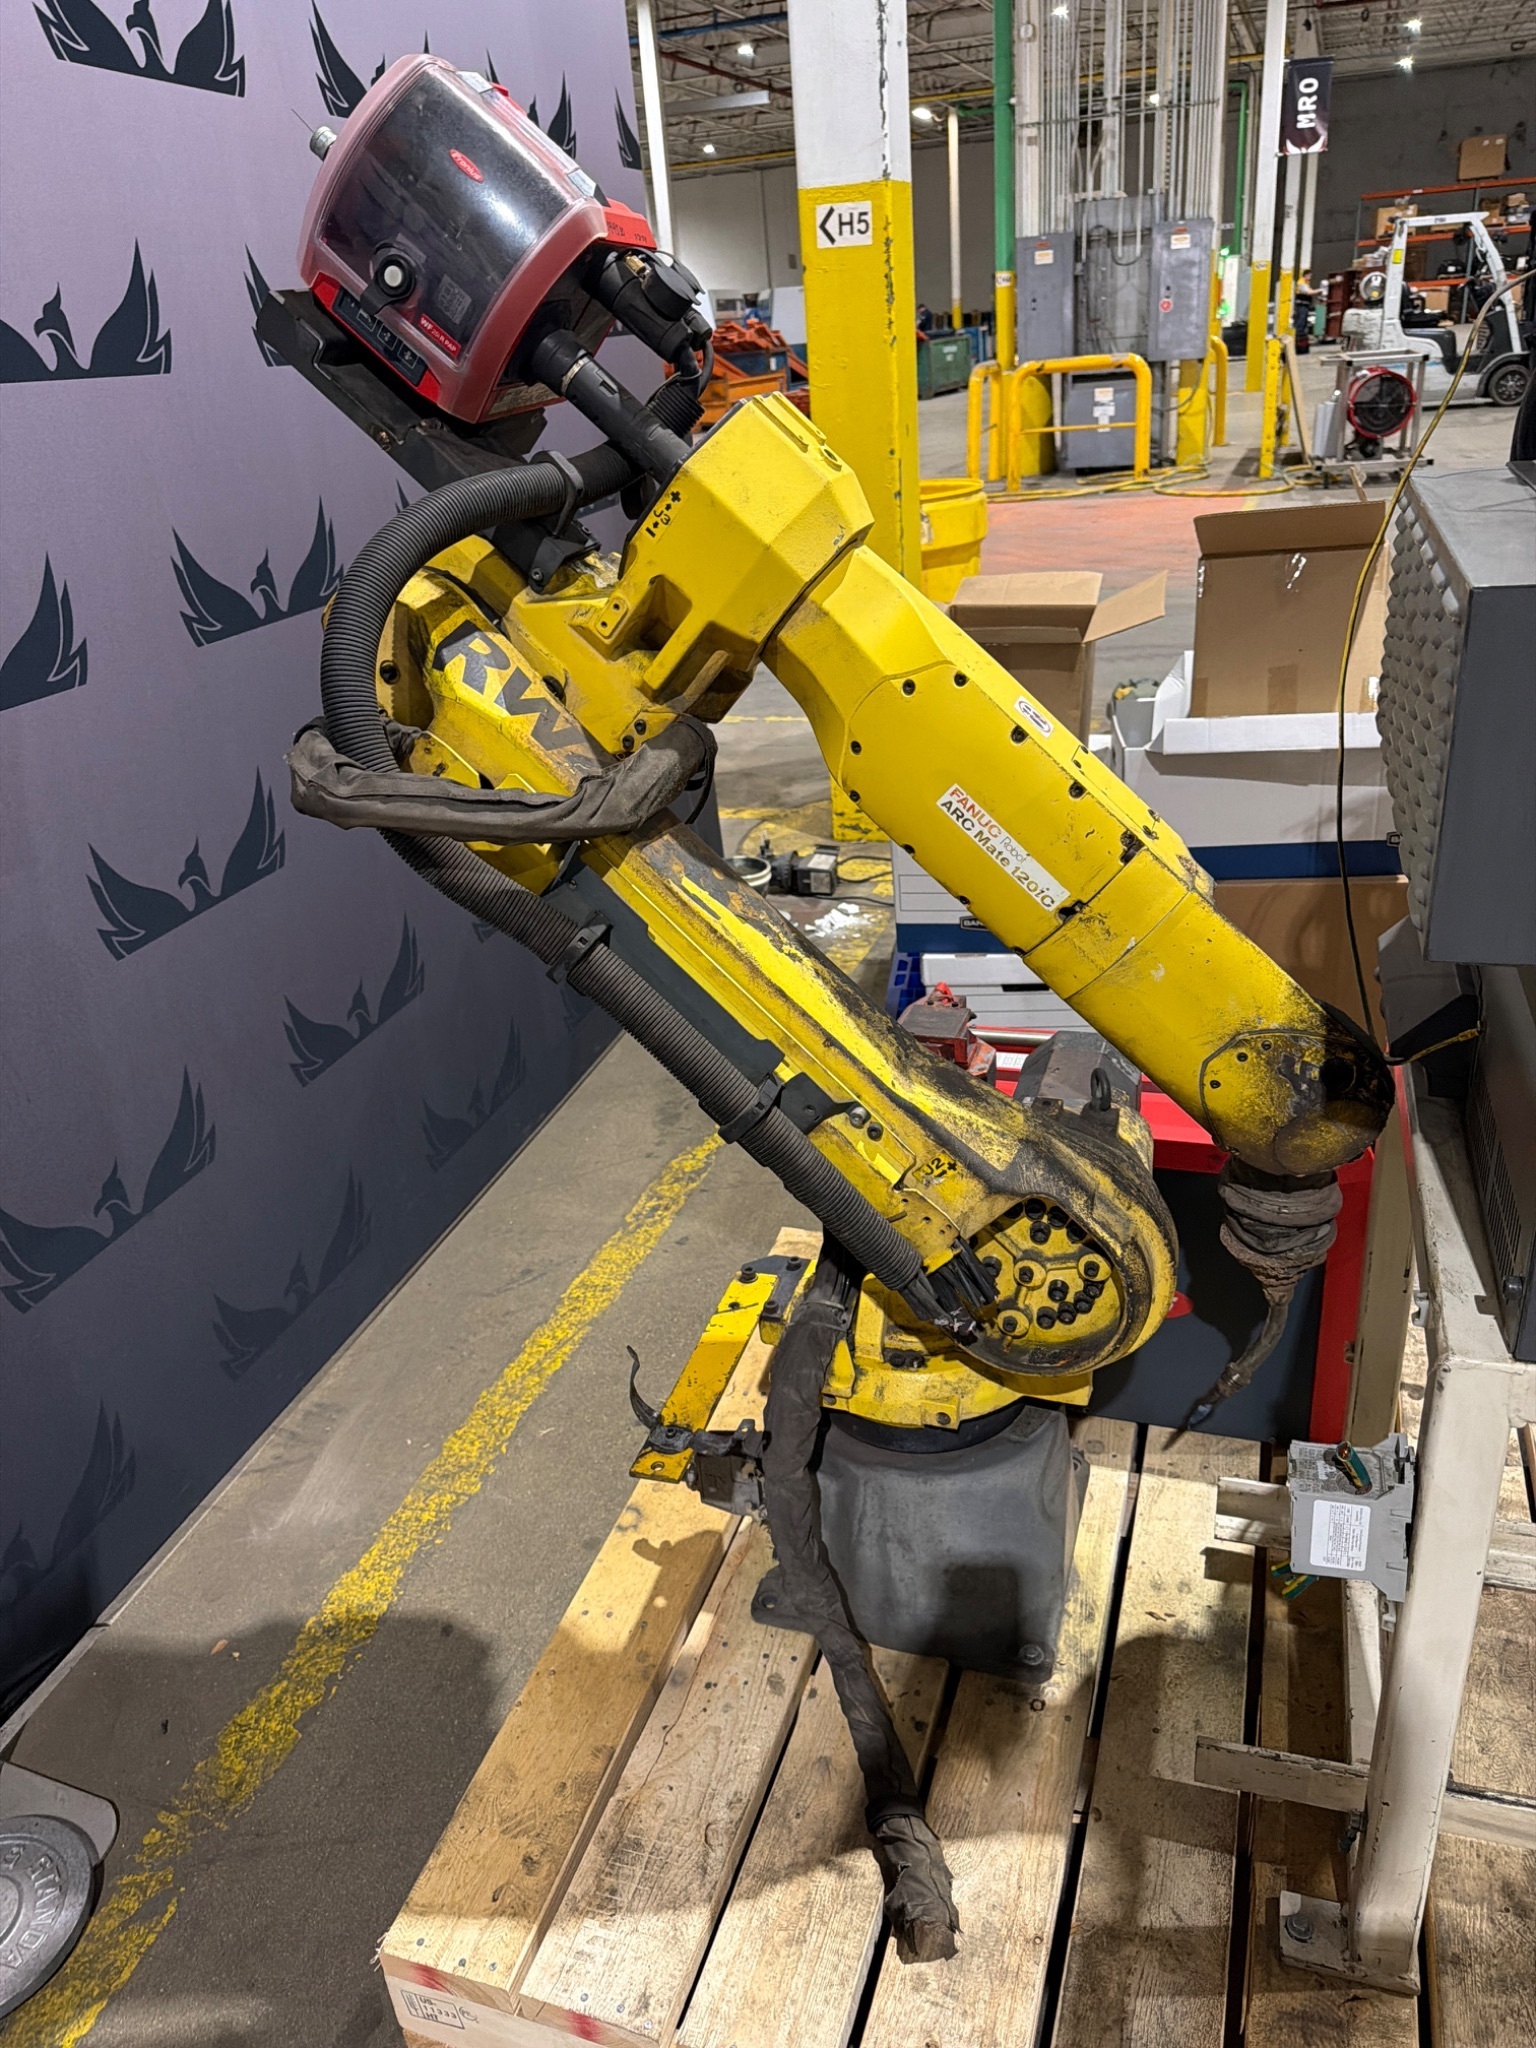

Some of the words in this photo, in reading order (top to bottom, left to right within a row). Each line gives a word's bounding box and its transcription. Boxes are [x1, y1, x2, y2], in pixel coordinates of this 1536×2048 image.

[1296, 77, 1320, 129] MRO
[838, 211, 870, 236] H5
[949, 787, 1001, 839] FANUC
[1000, 836, 1027, 864] Robot
[940, 800, 975, 832] ARC
[973, 830, 1011, 867] Mate
[1011, 866, 1055, 908] 120iC
[922, 1157, 946, 1176] J2
[422, 2005, 458, 2020] 11333
